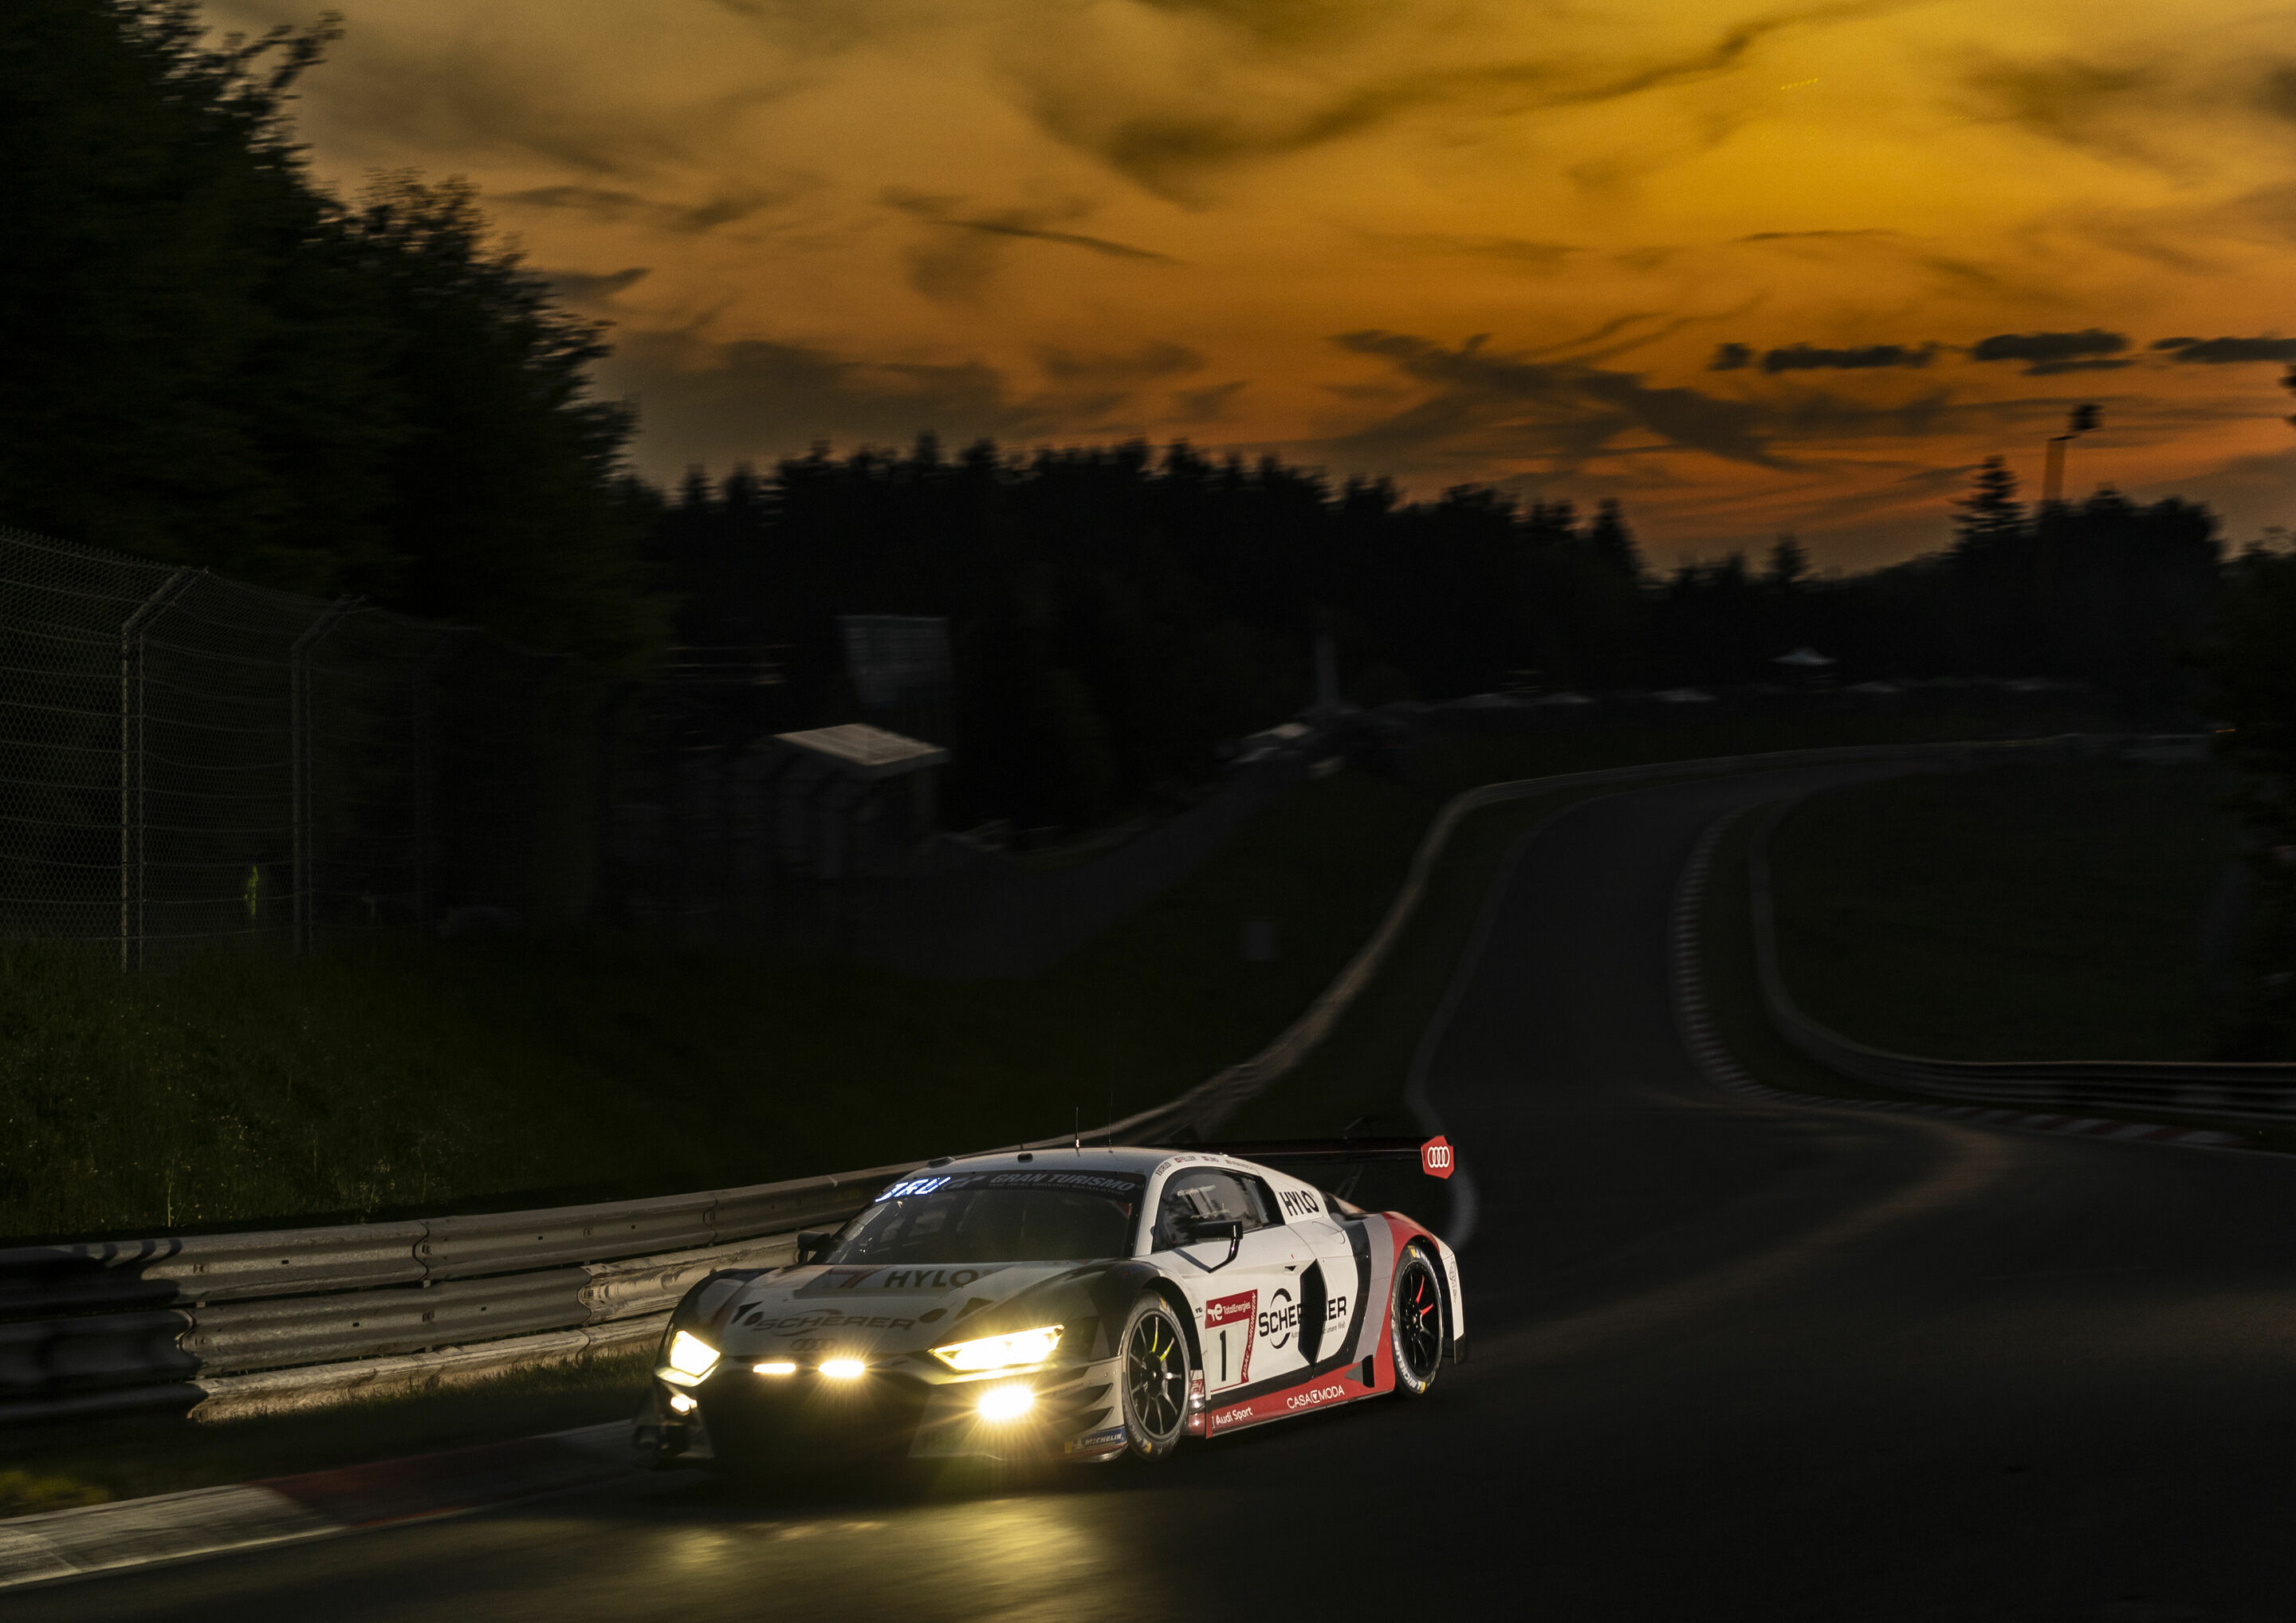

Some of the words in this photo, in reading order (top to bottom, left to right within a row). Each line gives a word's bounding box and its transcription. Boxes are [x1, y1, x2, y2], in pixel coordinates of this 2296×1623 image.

[991, 1173, 1048, 1184] GRAN
[1048, 1173, 1136, 1192] TURISMO
[1279, 1190, 1319, 1216] HYLO
[883, 1269, 979, 1288] HYLO
[1222, 1300, 1251, 1315] TotalEnergies
[1258, 1295, 1347, 1337] SCHEER
[753, 1313, 917, 1331] SCHERER
[1220, 1330, 1226, 1381] 1
[1287, 1395, 1311, 1409] CASA
[1319, 1385, 1345, 1401] MODA
[1216, 1413, 1233, 1425] Audi
[1233, 1406, 1253, 1421] Sport
[1085, 1432, 1122, 1446] MICHELIN
